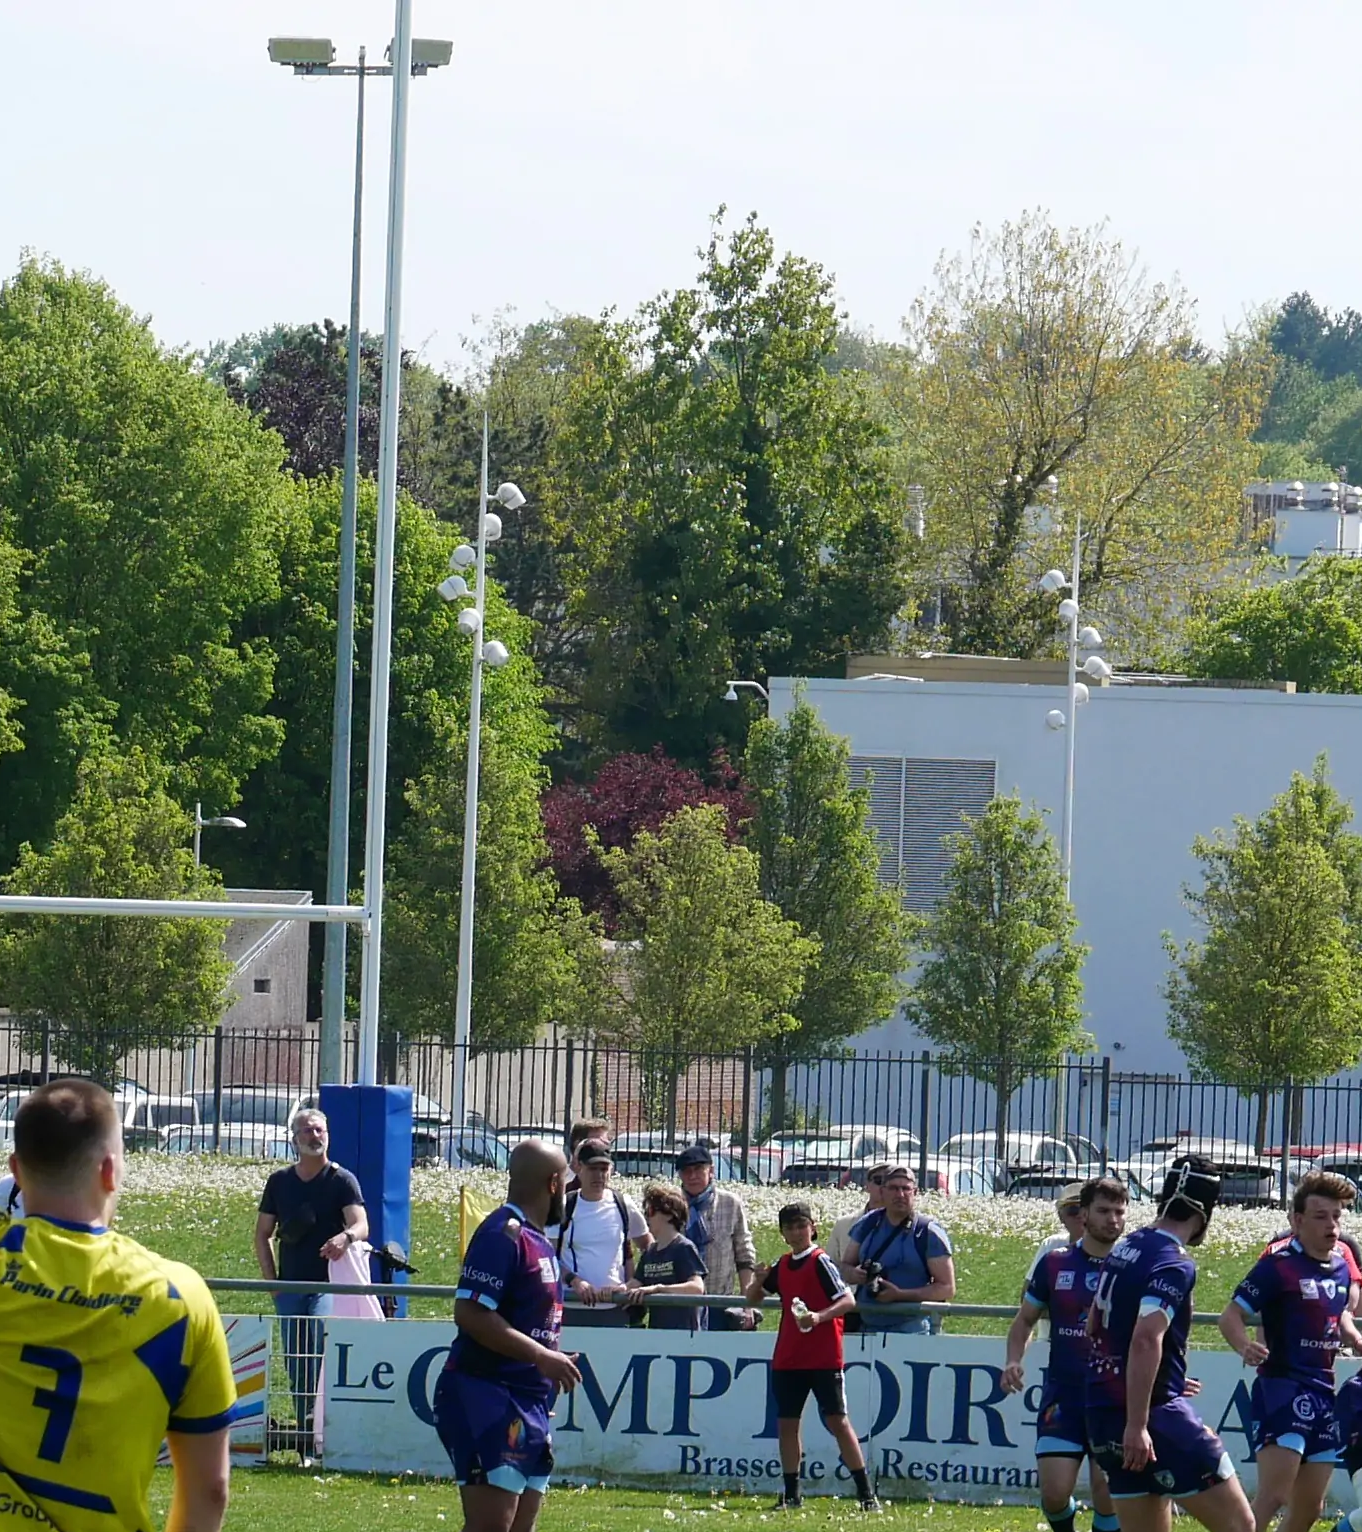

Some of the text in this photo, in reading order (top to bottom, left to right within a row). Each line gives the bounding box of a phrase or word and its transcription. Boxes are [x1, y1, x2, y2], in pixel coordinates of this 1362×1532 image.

[334, 1343, 395, 1390] Le
[20, 1344, 83, 1464] 7
[679, 1444, 826, 1481] Brasseie
[880, 1447, 1040, 1489] Restauran
